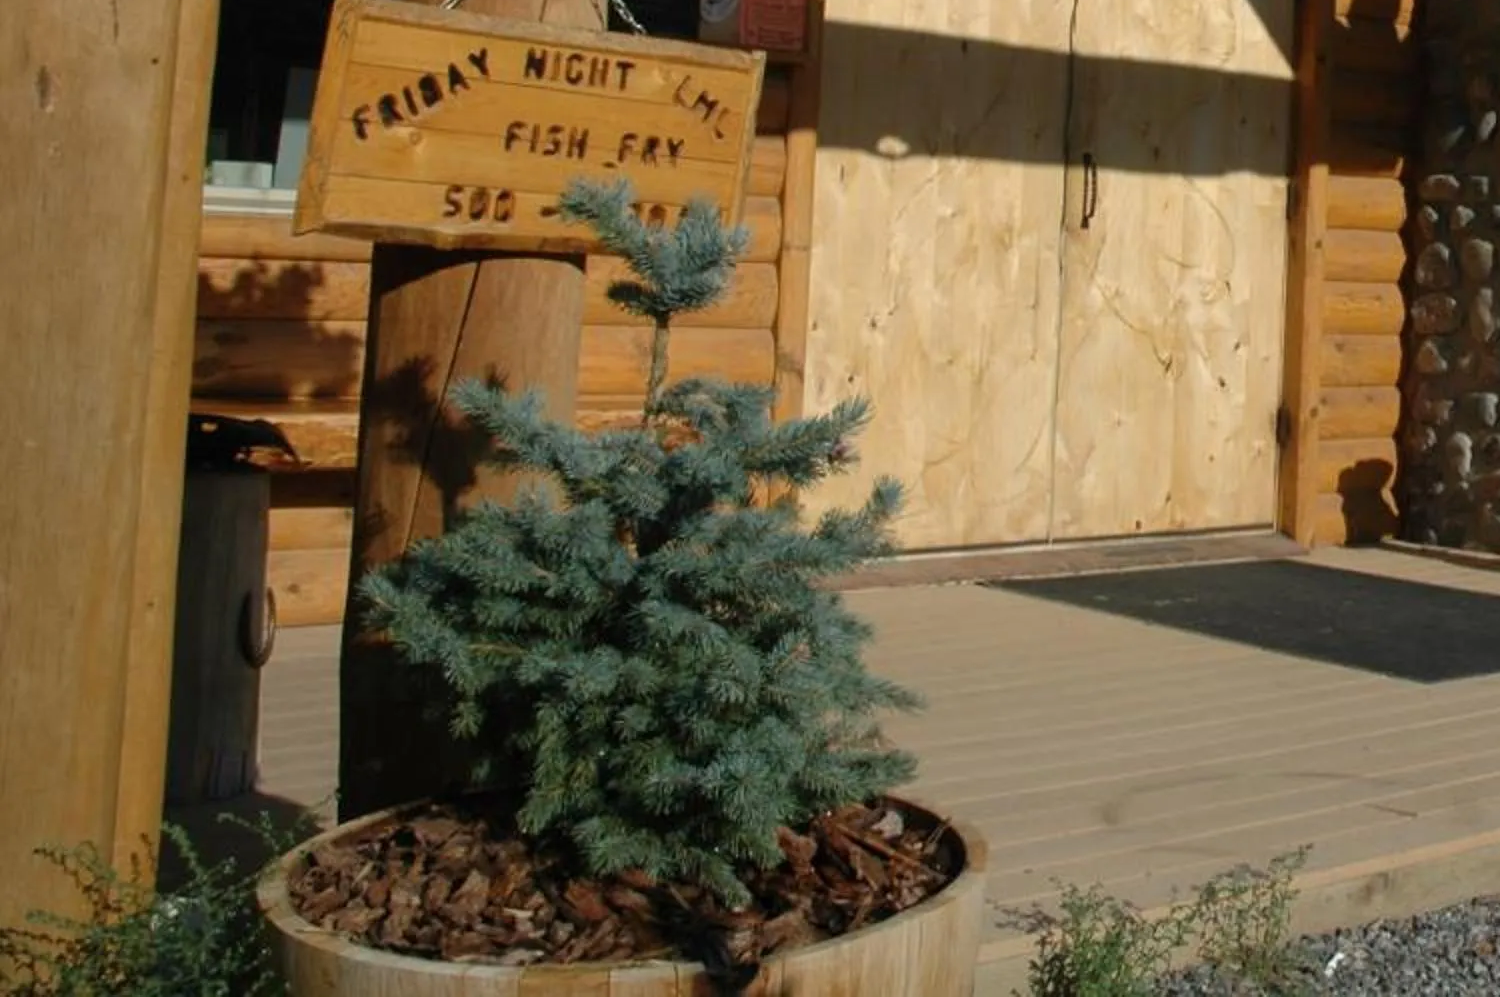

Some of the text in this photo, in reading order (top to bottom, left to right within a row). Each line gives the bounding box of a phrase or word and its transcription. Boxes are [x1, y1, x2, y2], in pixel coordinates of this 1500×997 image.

[352, 48, 490, 141] FRIDAY
[524, 47, 635, 91] NIGHT
[504, 120, 685, 167] FISH FRY
